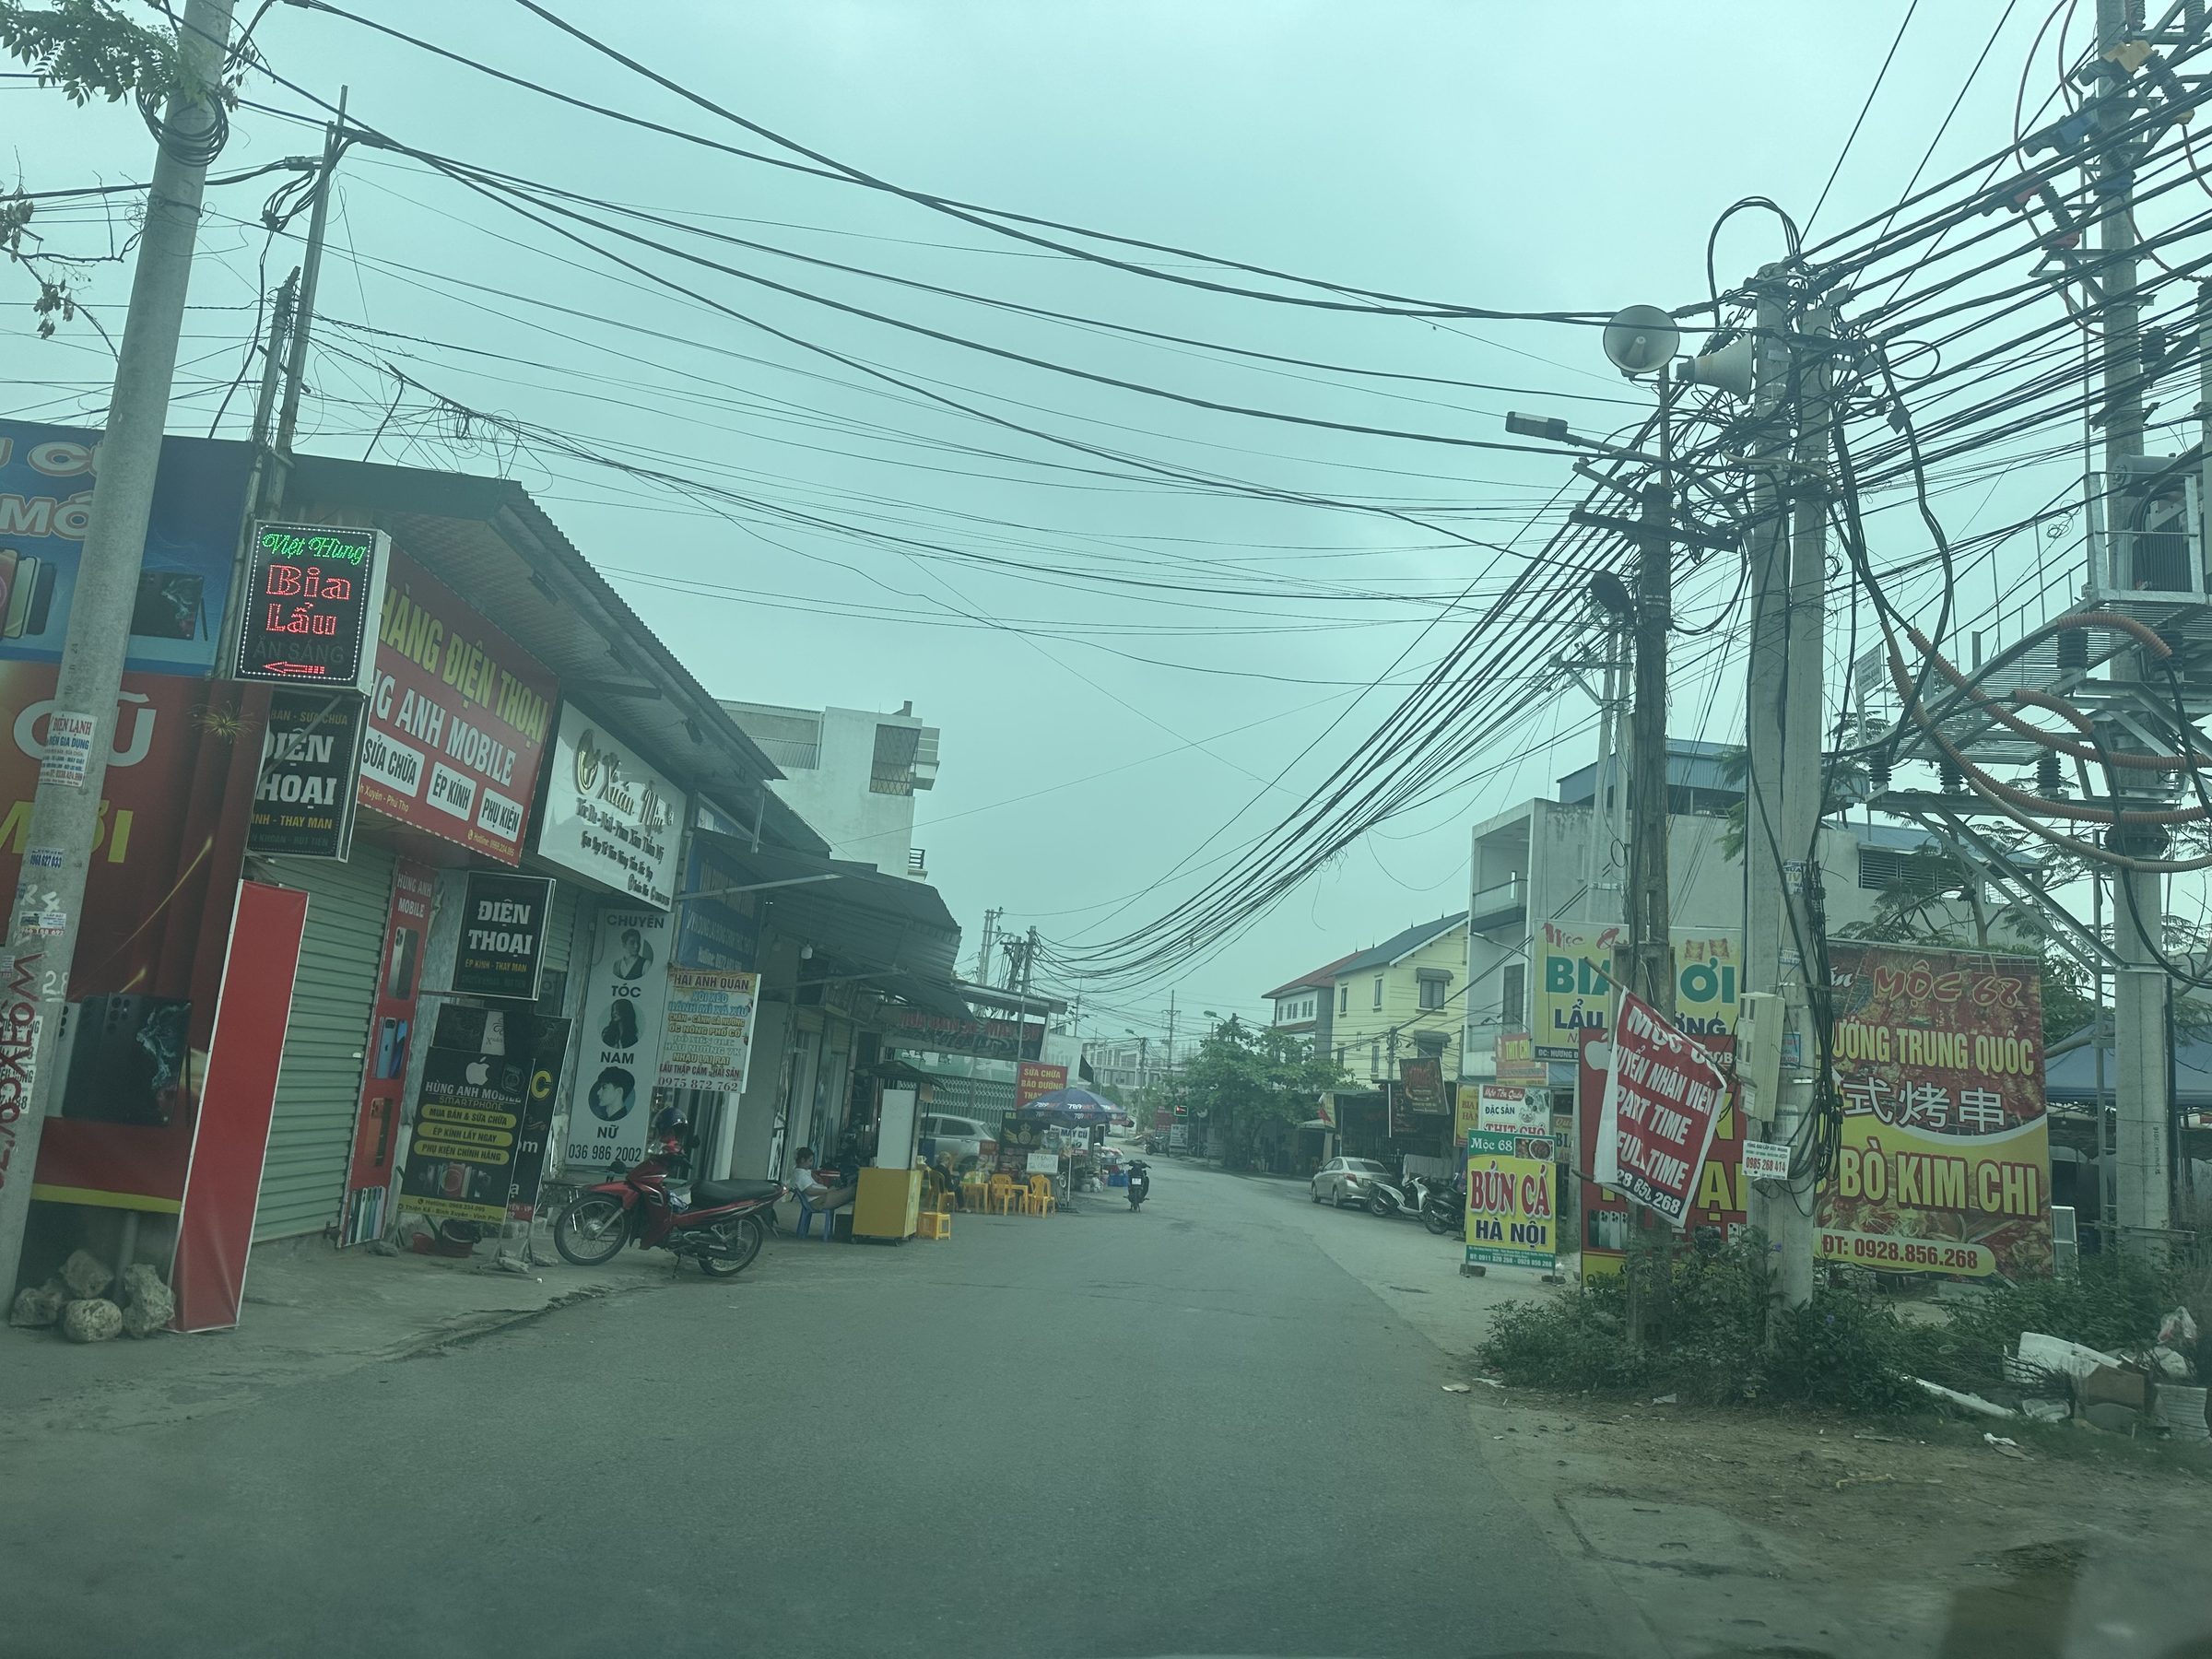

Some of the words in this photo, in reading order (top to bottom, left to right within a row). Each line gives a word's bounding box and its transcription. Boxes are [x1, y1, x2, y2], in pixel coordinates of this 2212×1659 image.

[262, 534, 306, 559] Việt
[309, 536, 367, 565] Hùng
[265, 564, 351, 600] Bia
[265, 602, 336, 636] Lẩu
[288, 639, 345, 664] SÁNG
[441, 631, 497, 710] ĐIỆN
[495, 669, 548, 748] THOẠI
[394, 688, 446, 748] ANH
[445, 716, 517, 787] MOBILE
[362, 735, 386, 771] SỬA
[387, 750, 418, 785] CHỮA
[256, 773, 337, 809] HOẠI
[432, 769, 446, 798] ÉP
[446, 779, 472, 810] KÍNH
[481, 797, 500, 829] PHỤ
[500, 805, 520, 835] KIỆN
[396, 871, 416, 892] HÙNG
[418, 882, 432, 898] ANH
[398, 897, 425, 918] MOBILE
[477, 898, 532, 927] ĐIỆN
[606, 912, 665, 929] CHUYÊN
[468, 929, 533, 958] THOẠI
[611, 982, 641, 998] TÓC
[695, 976, 717, 988] ANH
[1680, 957, 1735, 1004] ƠI
[1873, 959, 1962, 1009] MỘC
[1971, 975, 2023, 1008] 68
[1555, 998, 1604, 1030] LẨU
[600, 1051, 634, 1065] NAM
[1897, 1029, 1970, 1071] TRUNG
[1974, 1025, 2035, 1077] QUỐC
[425, 1079, 454, 1095] HÙNG
[456, 1086, 479, 1098] ANH
[658, 1077, 687, 1088] 0975
[690, 1078, 712, 1089] 872
[718, 1081, 738, 1091] 762
[1646, 1067, 1688, 1101] NHÂN
[1686, 1079, 1715, 1117] VIÊN
[429, 1108, 445, 1117] MUA
[1485, 1105, 1499, 1115] ĐẶC
[1500, 1104, 1515, 1114] SẢN
[1843, 1076, 2006, 1133] 式烤串
[597, 1125, 619, 1139] NỮ
[1648, 1104, 1692, 1146] TIME
[568, 1144, 589, 1159] 036
[592, 1145, 611, 1161] 986
[616, 1146, 642, 1163] 2002
[1471, 1137, 1495, 1152] Mộc
[1498, 1140, 1513, 1151] 68
[1645, 1148, 1689, 1190] TIME
[1761, 1159, 1774, 1171] 268
[1839, 1135, 1886, 1202] BÒ
[1896, 1151, 1966, 1211] KIM
[1975, 1161, 2040, 1218] CHI
[1470, 1160, 1515, 1213] BÚN
[1522, 1164, 1551, 1217] CÁ
[1654, 1192, 1682, 1215] 268
[1476, 1217, 1503, 1241] HÀ
[1510, 1220, 1547, 1248] NỘI
[1822, 1233, 1849, 1257] ĐT:
[1853, 1238, 1979, 1270] 0928.856.268
